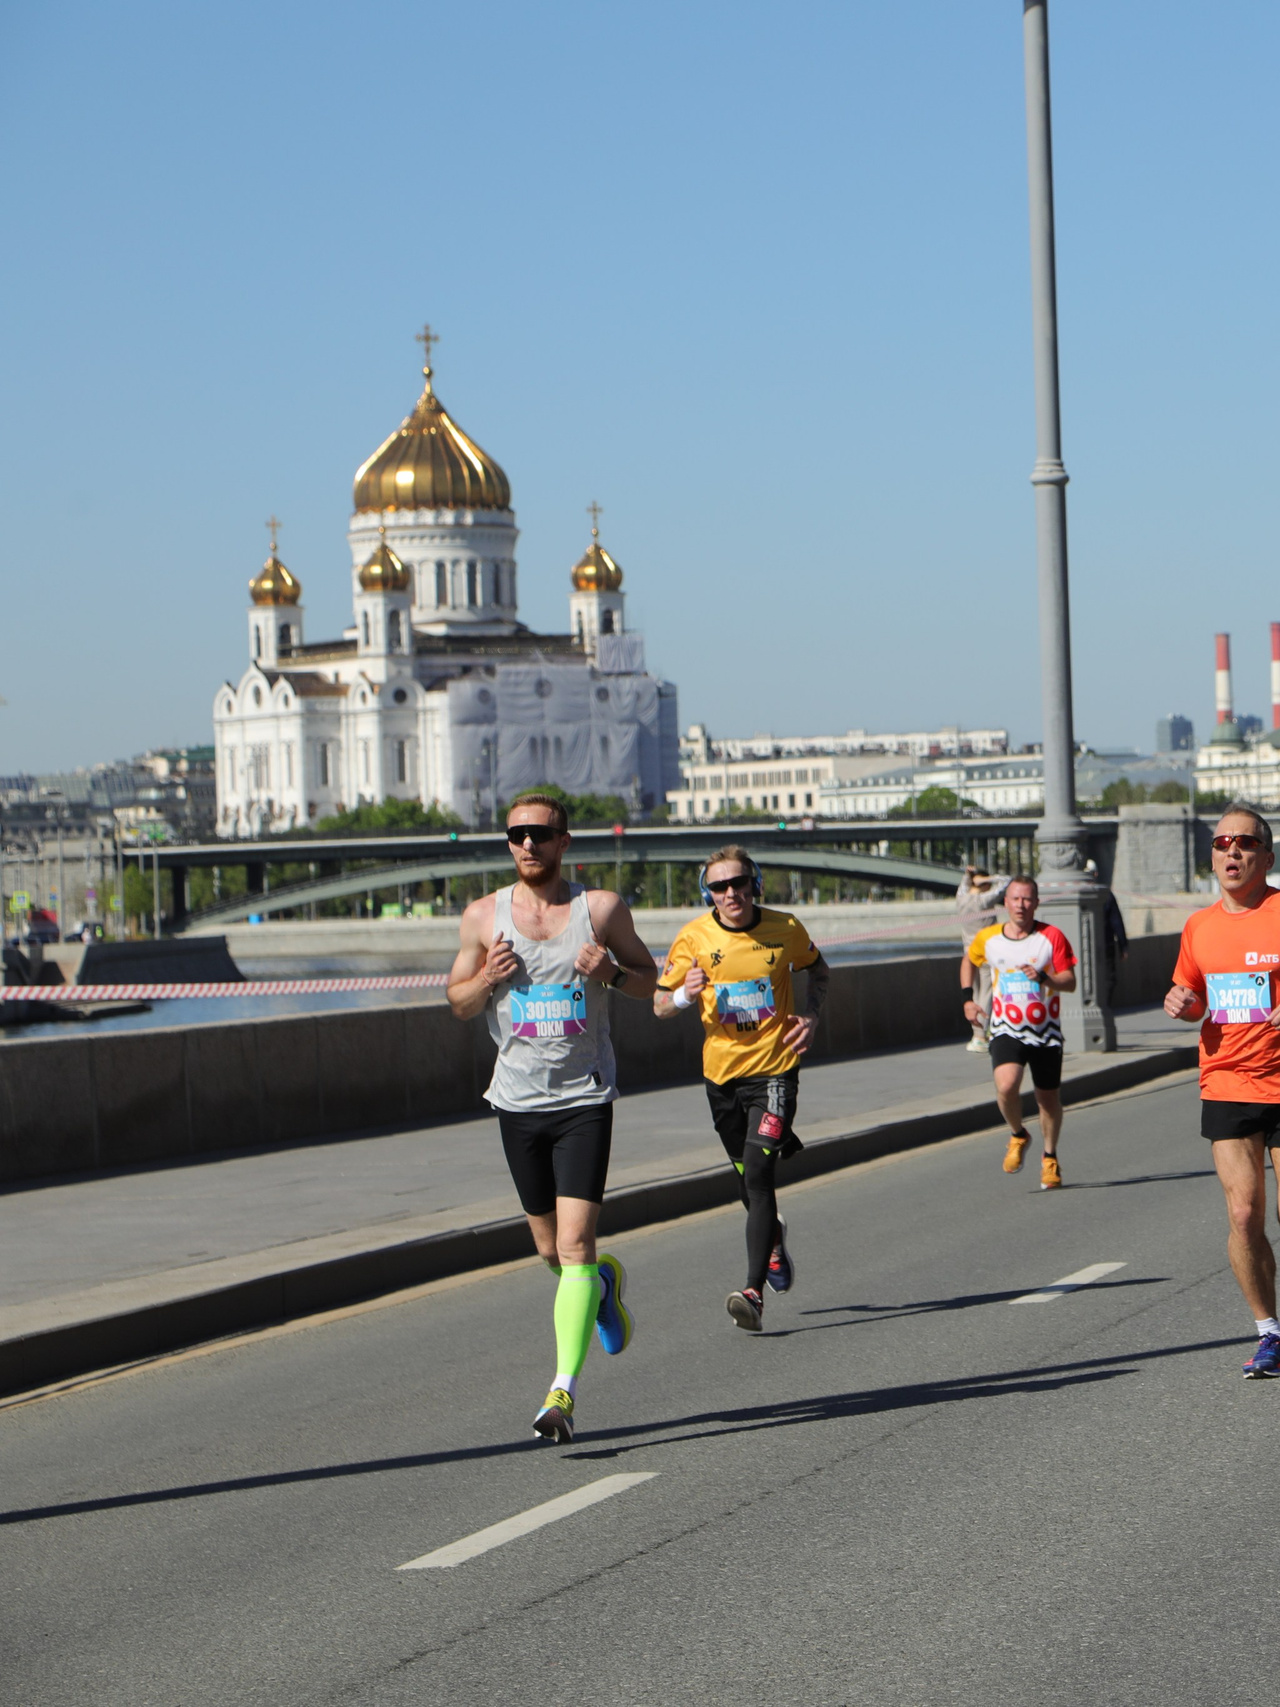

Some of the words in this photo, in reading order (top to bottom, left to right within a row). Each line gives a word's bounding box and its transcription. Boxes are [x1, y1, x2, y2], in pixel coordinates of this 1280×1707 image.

[1259, 954, 1280, 963] АТБ
[1219, 988, 1257, 1008] 34778
[525, 999, 572, 1020] 30199
[1226, 1008, 1251, 1023] 10KM
[535, 1020, 565, 1037] 10KM
